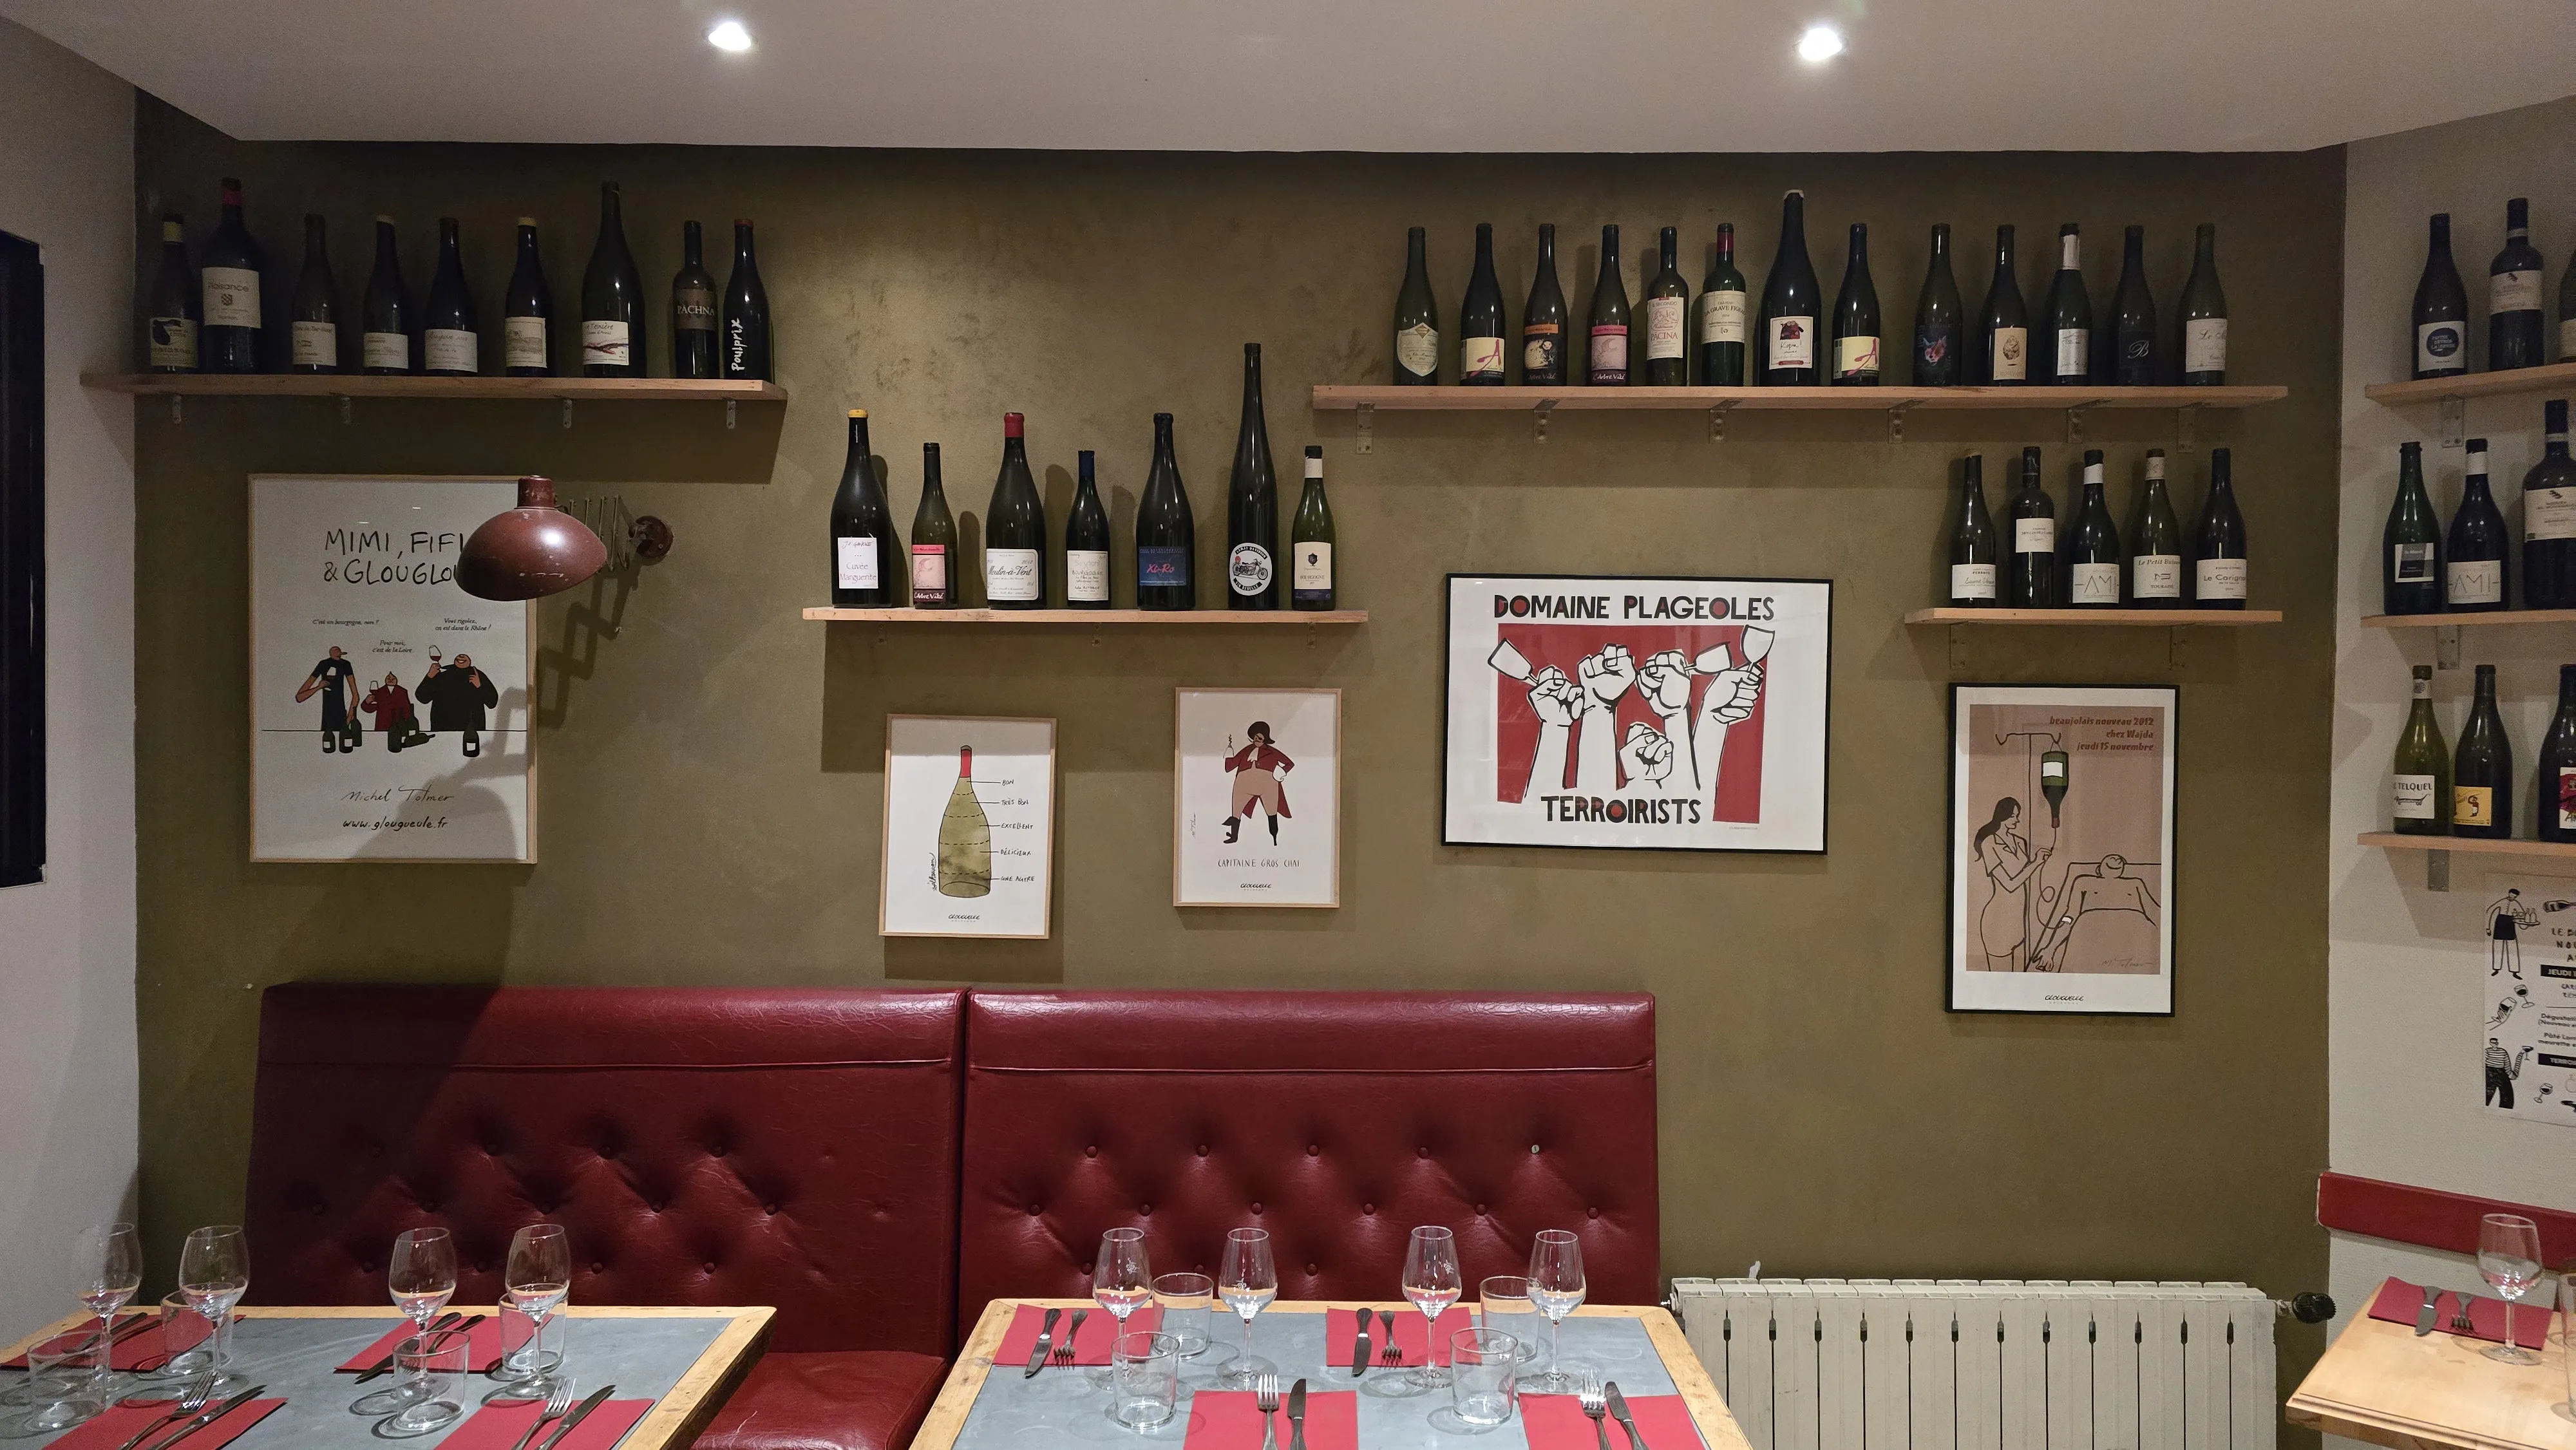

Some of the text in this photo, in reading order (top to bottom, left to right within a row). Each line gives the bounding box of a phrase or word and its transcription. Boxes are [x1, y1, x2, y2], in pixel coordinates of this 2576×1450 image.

[846, 562, 869, 570] Cuvée
[840, 573, 877, 585] Marguerite
[1494, 594, 1775, 621] DOMAINE PLAGEOLES
[2050, 716, 2154, 727] beaujolais nouveau 2012
[2107, 729, 2154, 740] chez Wajda
[2077, 742, 2099, 751] jeudi
[2110, 742, 2154, 751] novembre
[1540, 795, 1701, 825] TERROIRISTS
[342, 816, 450, 833] www.glougueule.fr
[1218, 858, 1300, 868] CAPITAINE GROS CHAI
